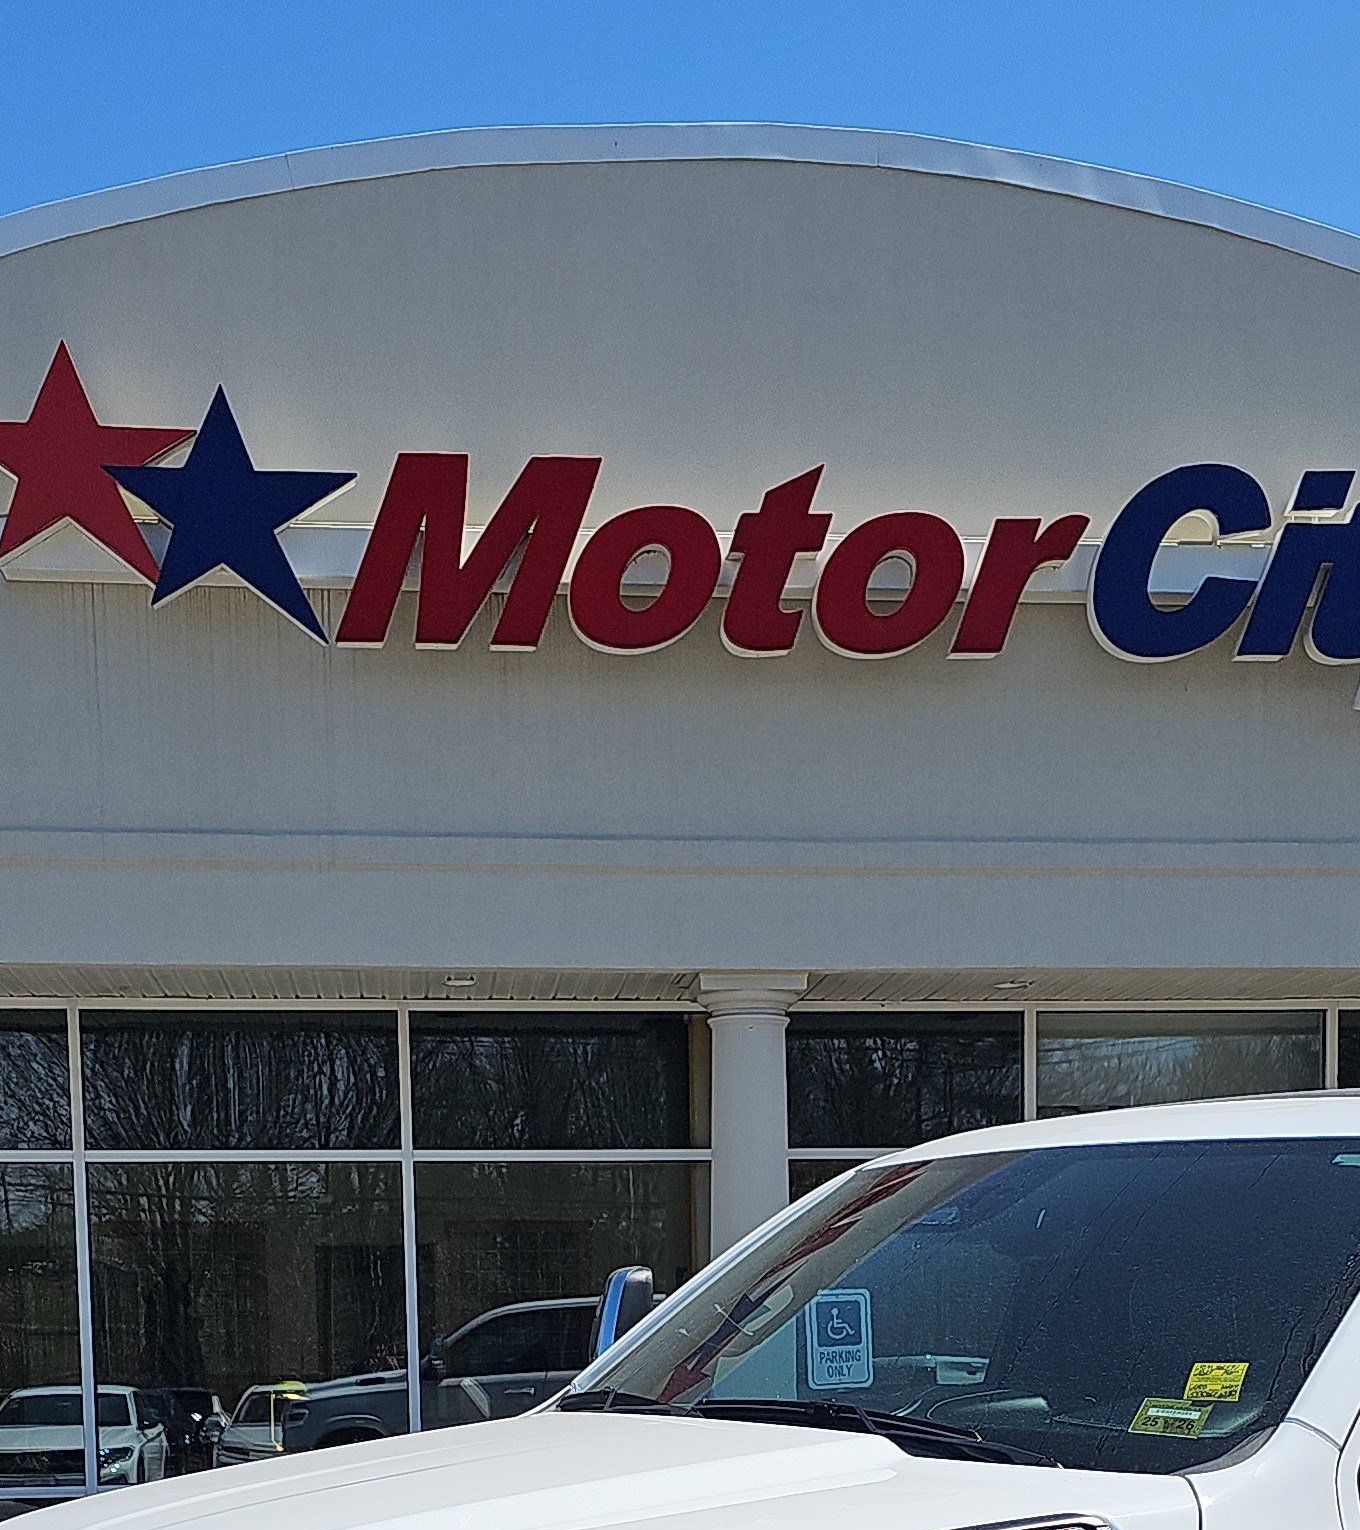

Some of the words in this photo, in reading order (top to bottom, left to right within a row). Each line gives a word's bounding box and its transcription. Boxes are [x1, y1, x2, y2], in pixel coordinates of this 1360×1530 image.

[819, 1349, 862, 1364] PARKING
[826, 1363, 853, 1378] ONLY
[1141, 1416, 1159, 1427] 25
[1176, 1419, 1196, 1431] 26
